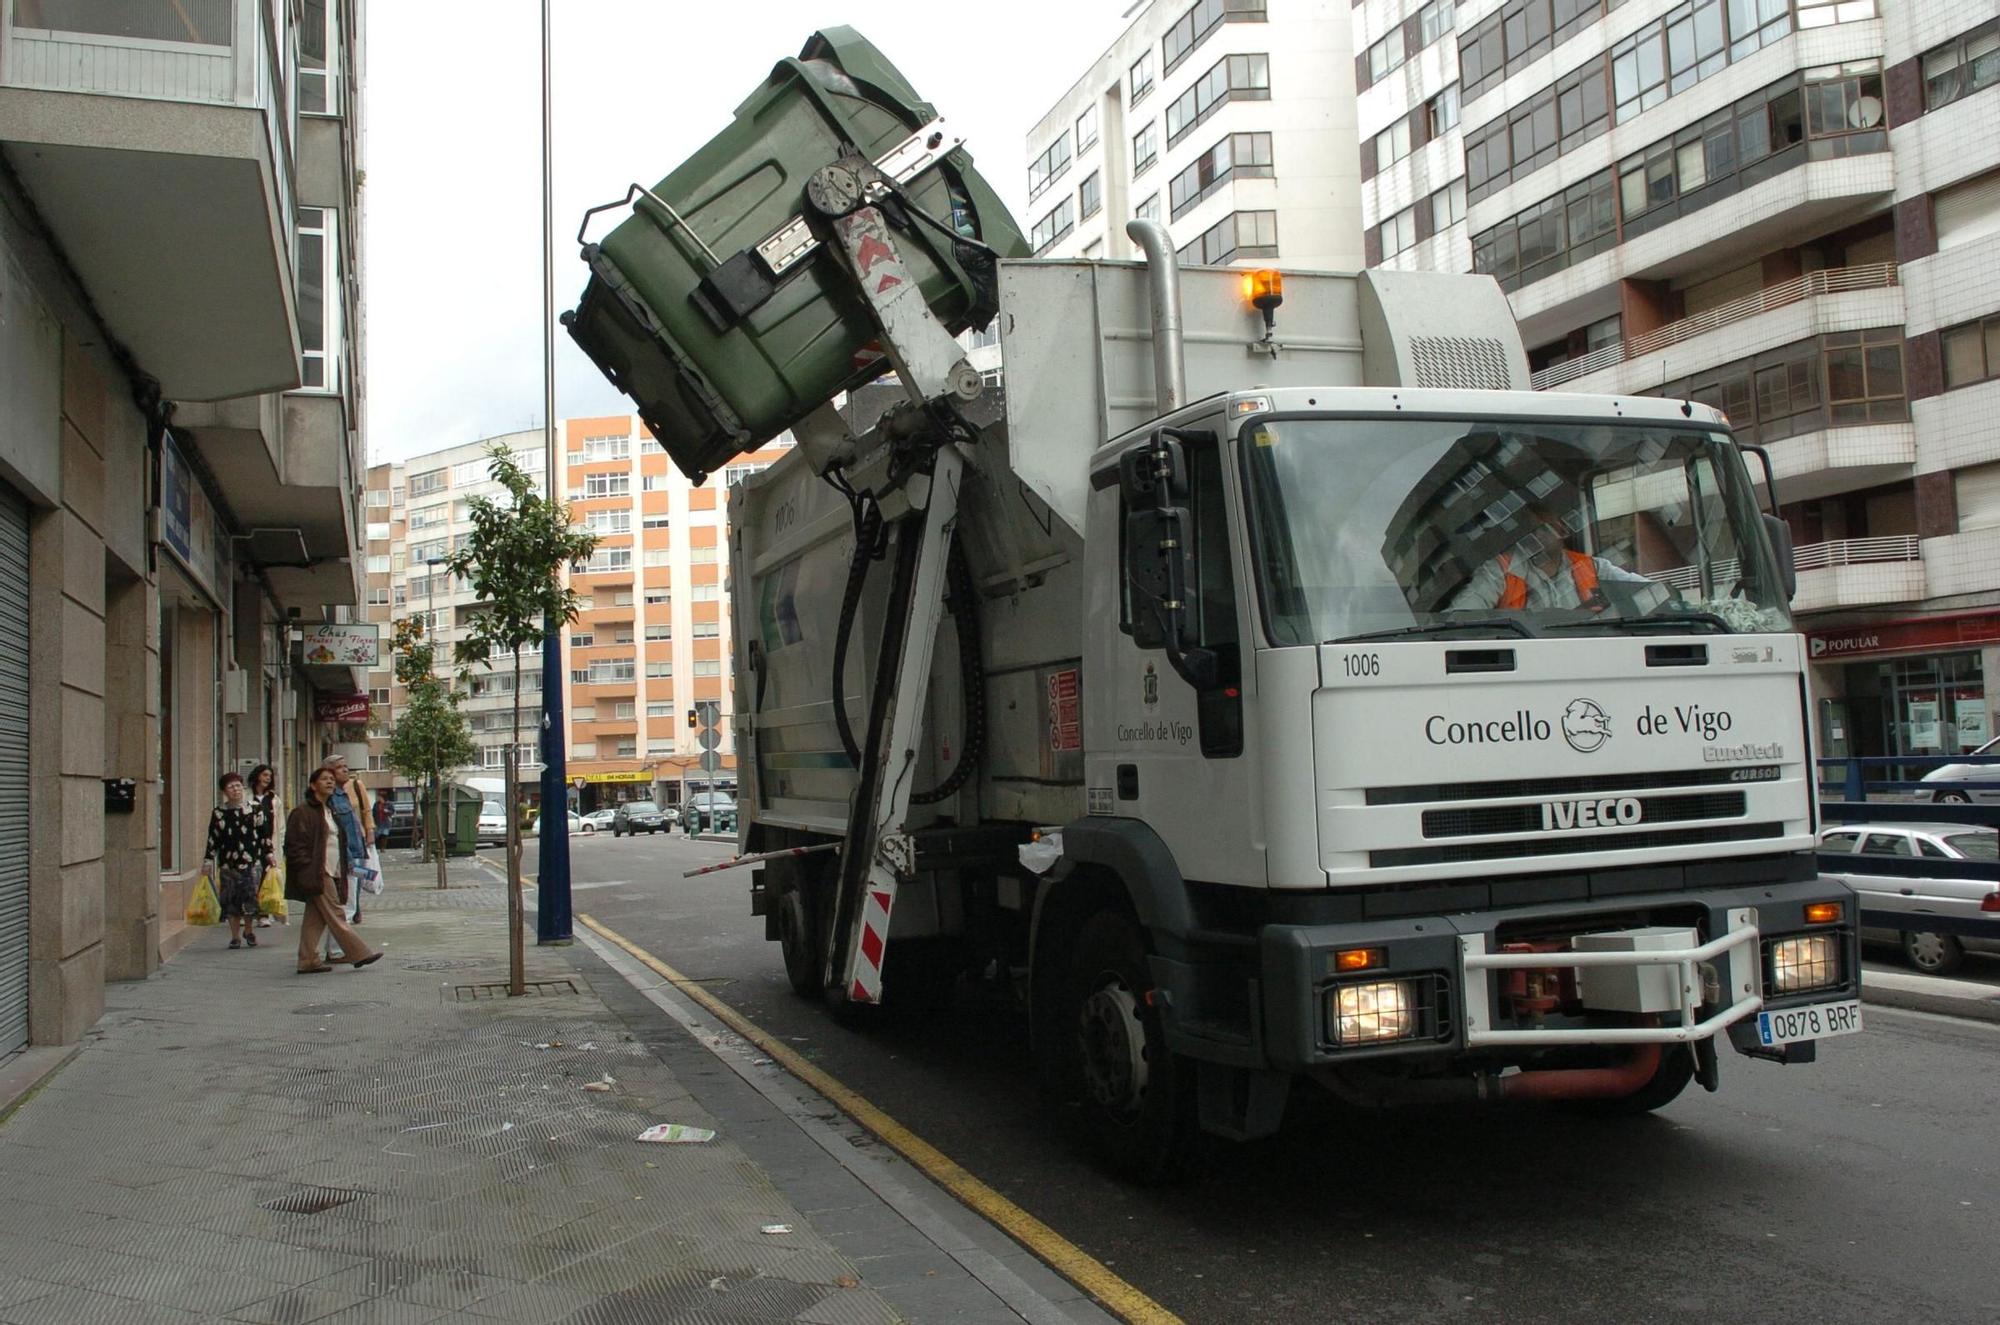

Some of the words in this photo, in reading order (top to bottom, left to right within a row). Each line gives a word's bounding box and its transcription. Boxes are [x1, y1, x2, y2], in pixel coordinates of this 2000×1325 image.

[1829, 635, 1879, 650] POPULAR
[1343, 654, 1380, 677] 1006
[1118, 721, 1155, 741] Concello
[1157, 720, 1168, 740] de
[1170, 720, 1192, 745] Vigo
[1425, 710, 1551, 745] Concello
[1636, 705, 1668, 735] de
[1674, 703, 1732, 741] Vigo
[1703, 742, 1784, 762] EuroTech
[1731, 766, 1780, 780] CURSOR
[1541, 796, 1642, 831] IVECO
[1774, 1010, 1820, 1039] 0878
[1826, 1004, 1858, 1032] BRF
[1763, 1031, 1770, 1040] E
